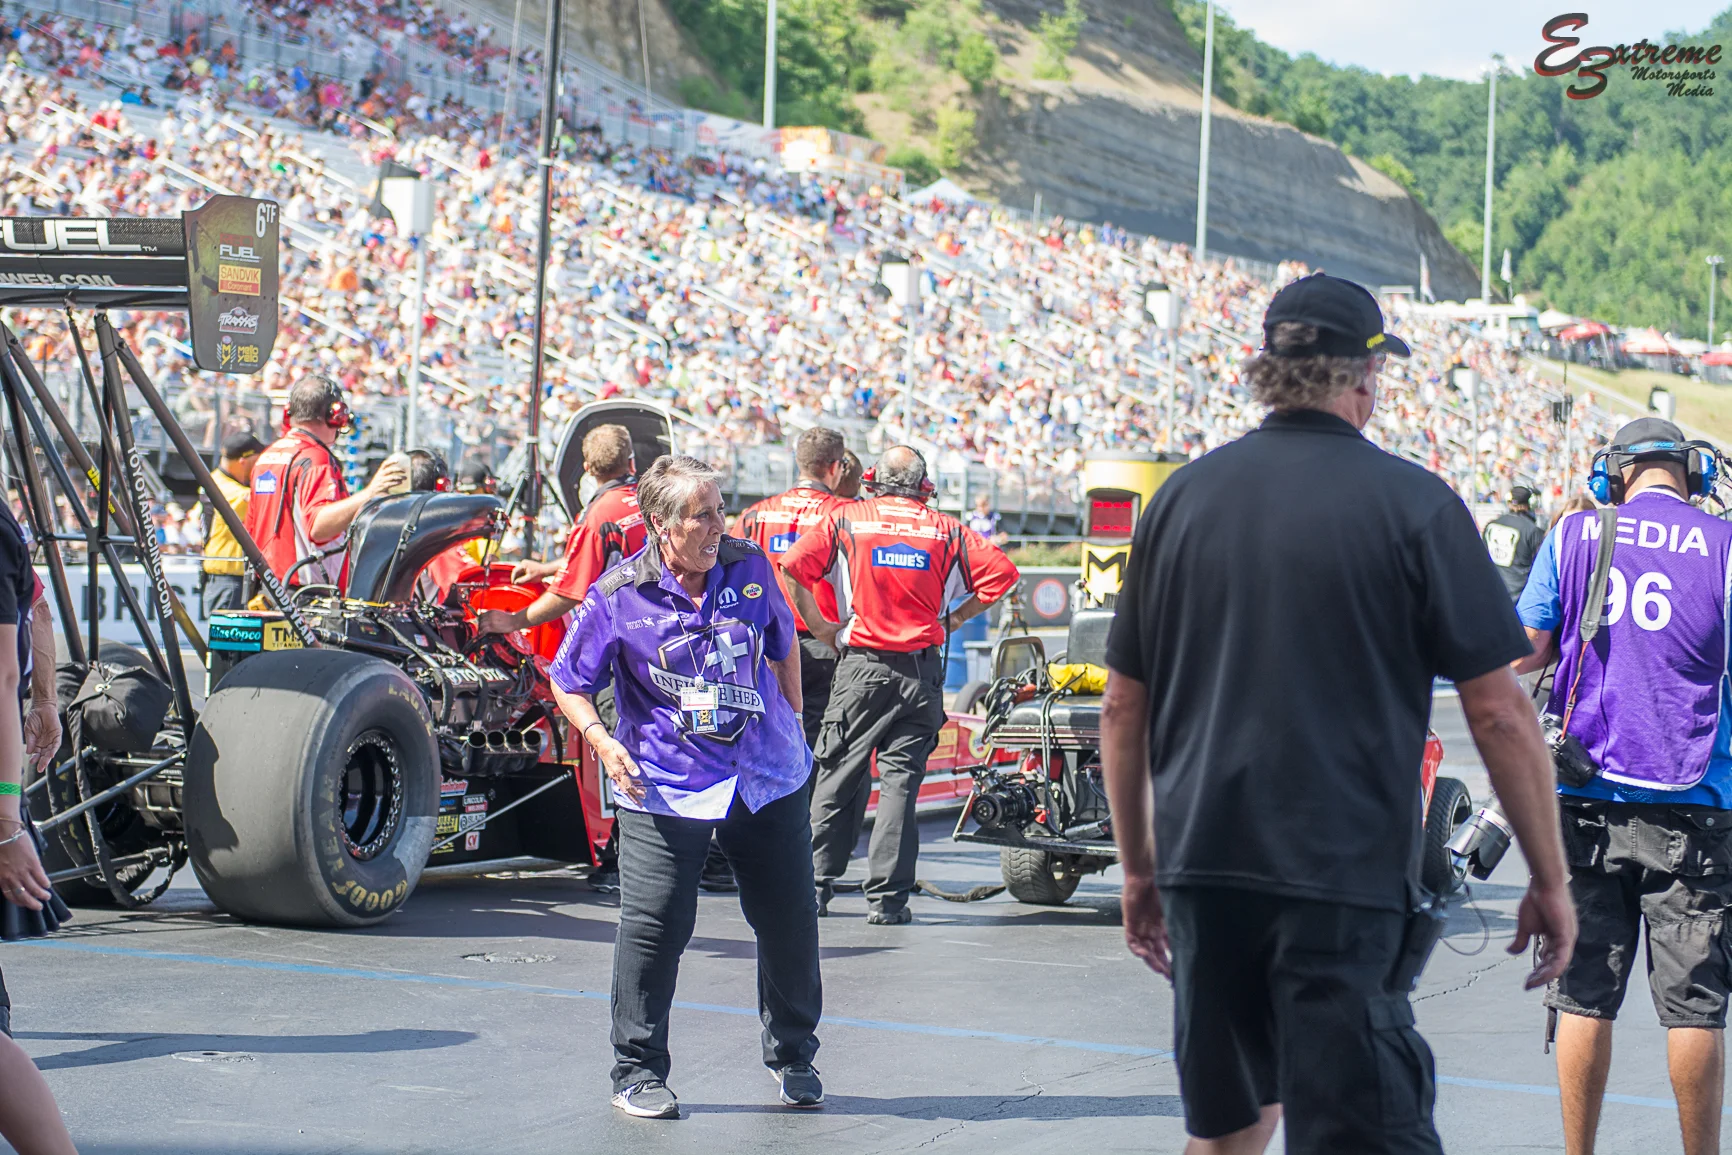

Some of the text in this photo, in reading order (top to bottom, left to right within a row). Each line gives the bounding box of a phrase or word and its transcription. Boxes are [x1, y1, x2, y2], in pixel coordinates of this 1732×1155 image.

[0, 219, 142, 251] UEL
[220, 244, 260, 259] FUEL
[0, 273, 117, 287] WER.COM
[220, 266, 260, 282] SANDVIK
[127, 443, 173, 619] TOYOTARACING.COM
[1581, 516, 1709, 557] MEDIA
[877, 549, 925, 568] LOWE'S
[263, 568, 316, 646] GOODYEAR
[1587, 566, 1673, 632] 96
[230, 627, 261, 642] Copco
[456, 668, 510, 682] TOOTA
